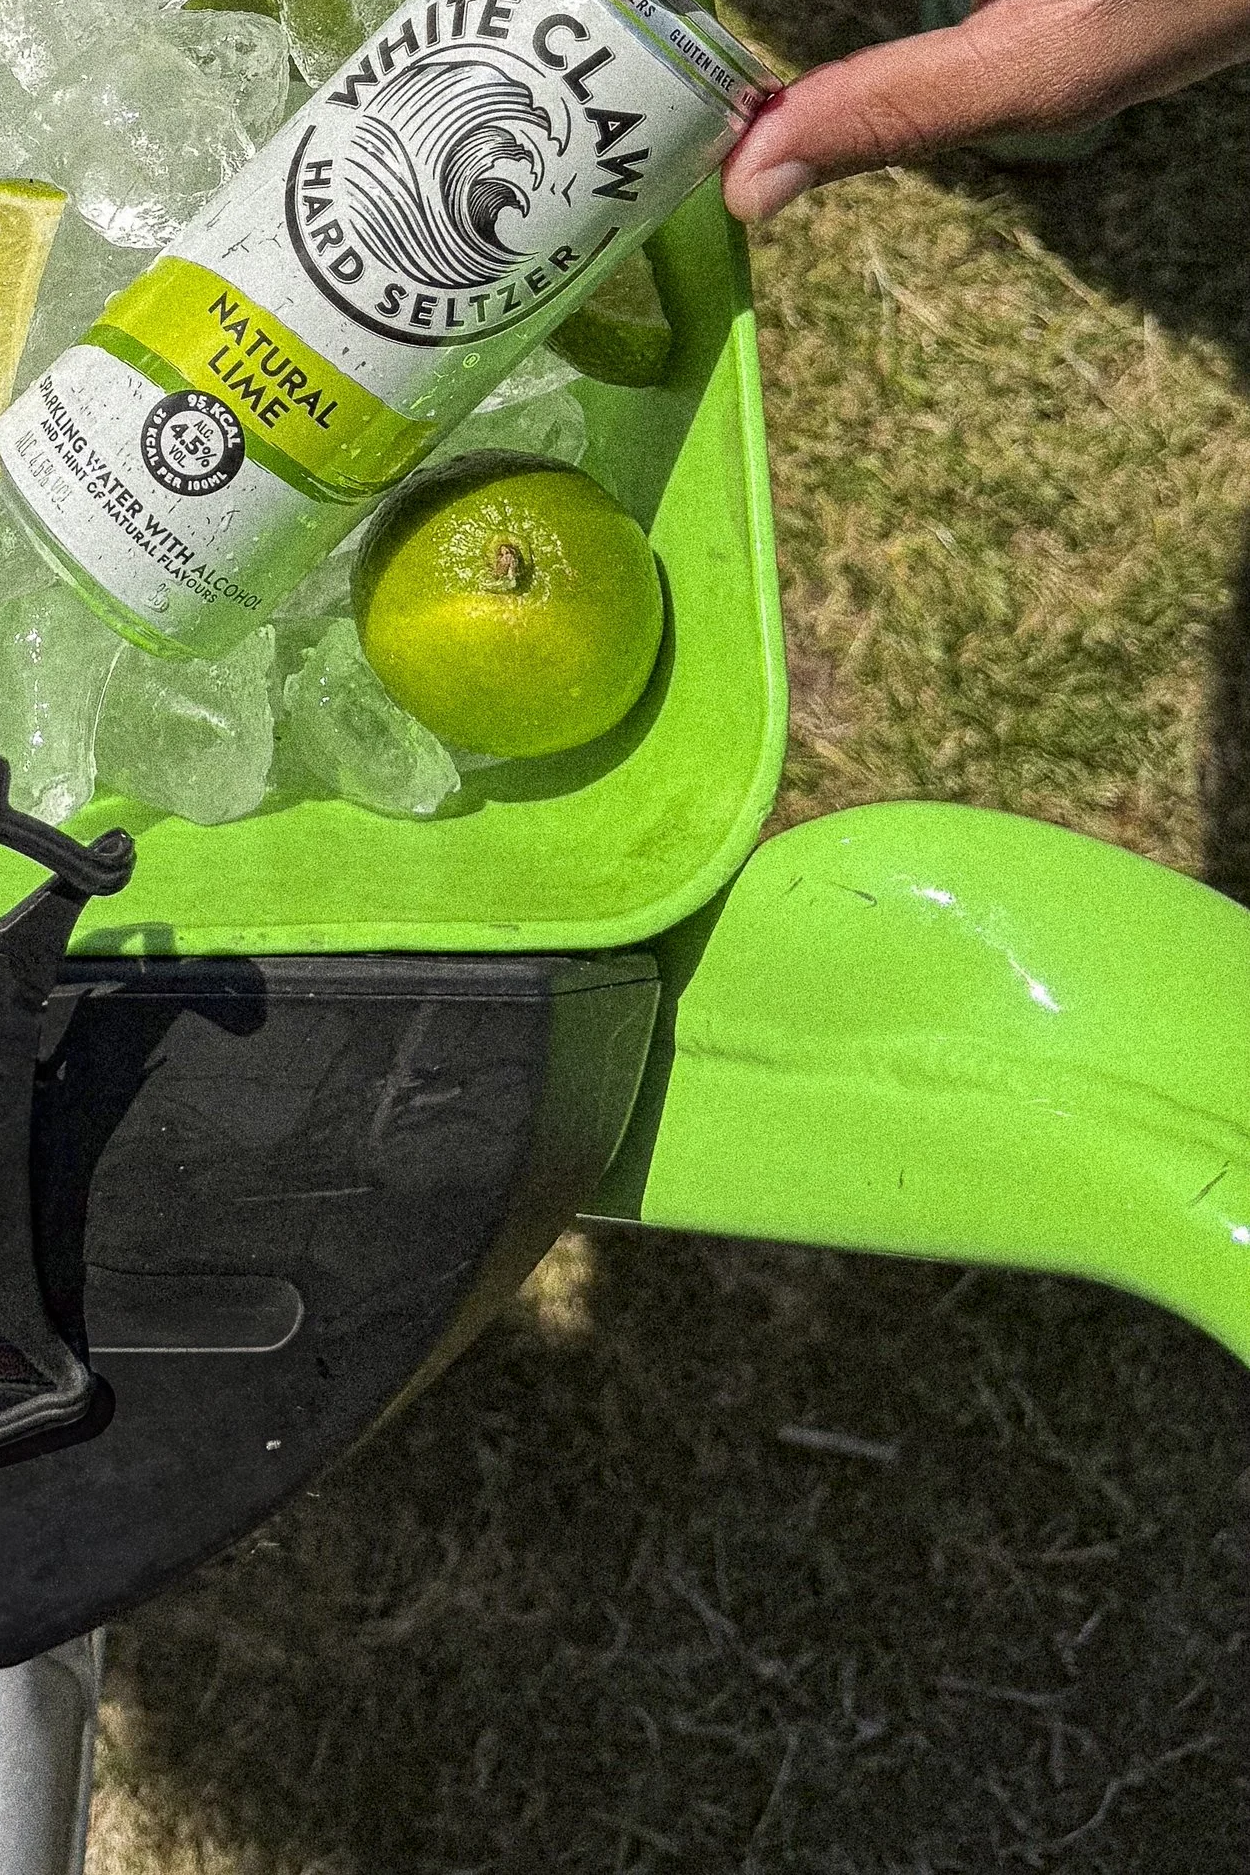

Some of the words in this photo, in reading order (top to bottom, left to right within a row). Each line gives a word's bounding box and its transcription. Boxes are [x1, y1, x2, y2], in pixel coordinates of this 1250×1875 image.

[532, 13, 652, 204] CLAW
[669, 28, 714, 72] GLUTEN
[709, 64, 736, 94] FREE
[301, 157, 366, 285] HARD
[376, 244, 582, 329] SELTZER
[207, 290, 343, 431] NATURAL
[207, 345, 293, 430] LIME
[145, 426, 160, 466] KCAL
[156, 466, 182, 489] PER
[187, 471, 228, 491] 100ML
[170, 423, 218, 468] 4.5%
[210, 402, 241, 449] KCAL
[39, 375, 87, 454] SPARKLING
[86, 449, 144, 519] WATER
[144, 513, 195, 566] WITH
[190, 563, 263, 611] ALCOHOL
[40, 418, 59, 442] AND
[54, 442, 65, 454] A
[62, 450, 89, 481] HINT
[102, 499, 158, 557] NATURAL
[157, 554, 218, 604] FLAVOURS
